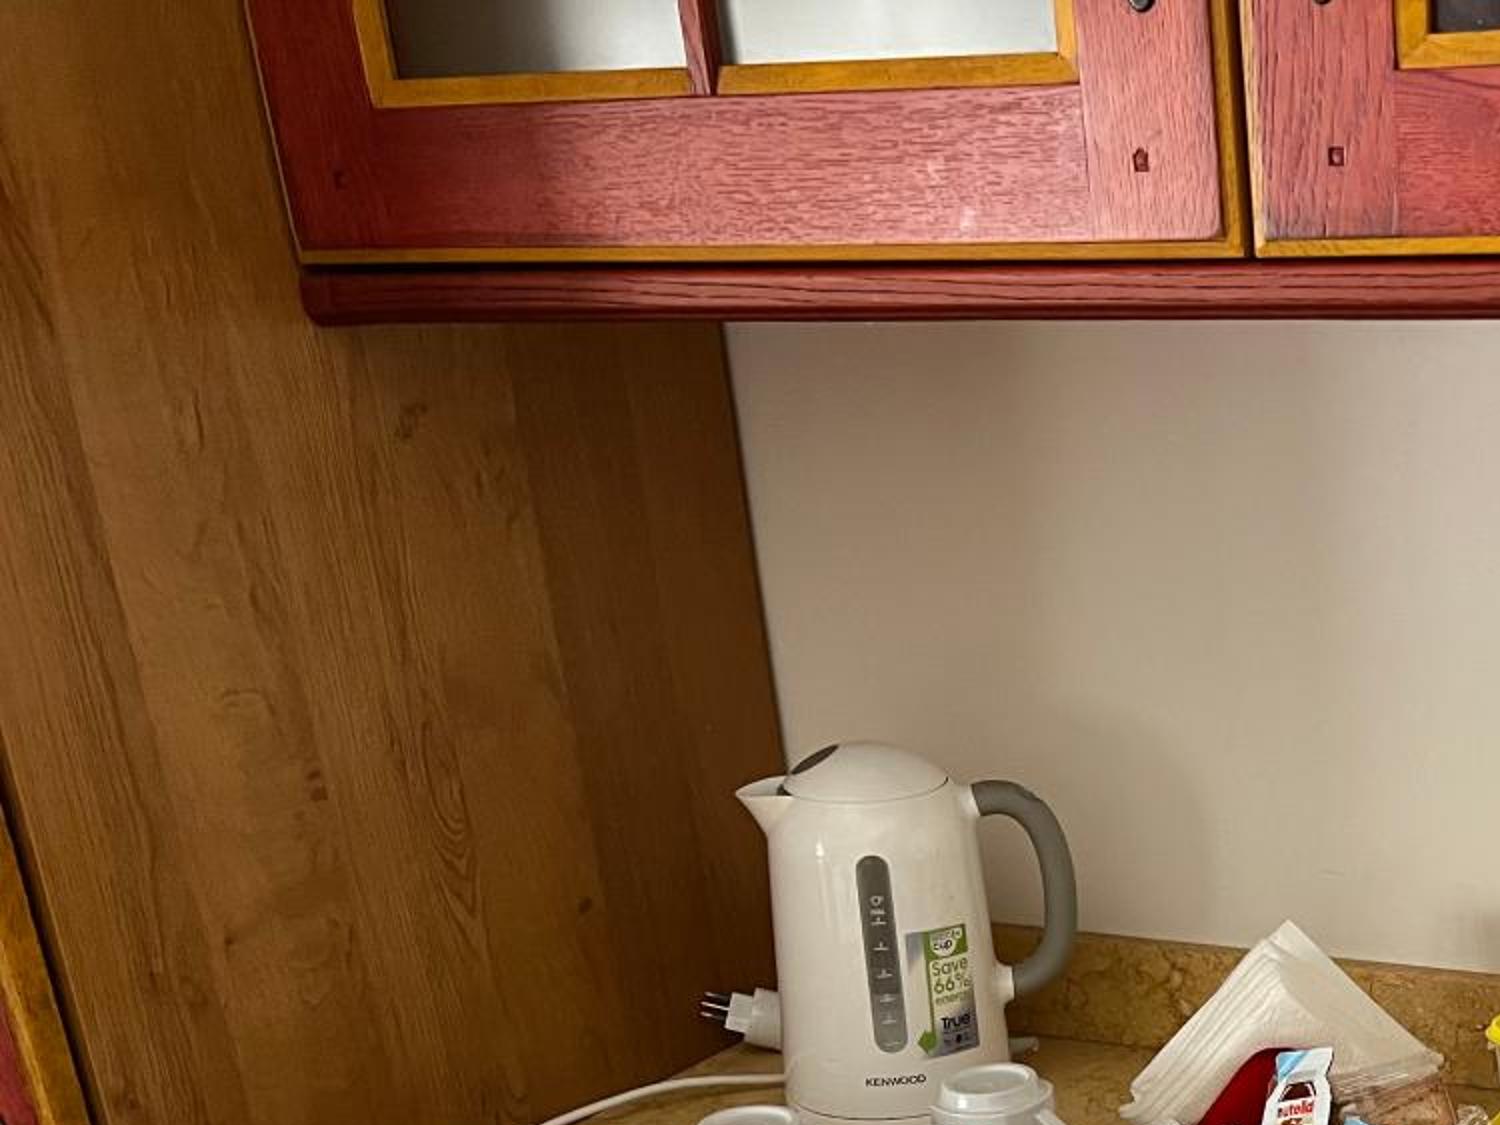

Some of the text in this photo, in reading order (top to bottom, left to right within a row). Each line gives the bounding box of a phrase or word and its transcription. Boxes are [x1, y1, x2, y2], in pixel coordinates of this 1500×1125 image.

[932, 957, 968, 977] Save
[934, 972, 973, 994] 66%
[941, 1013, 971, 1030] True
[865, 1073, 927, 1088] KENWOOD
[1278, 1100, 1315, 1119] nutella
